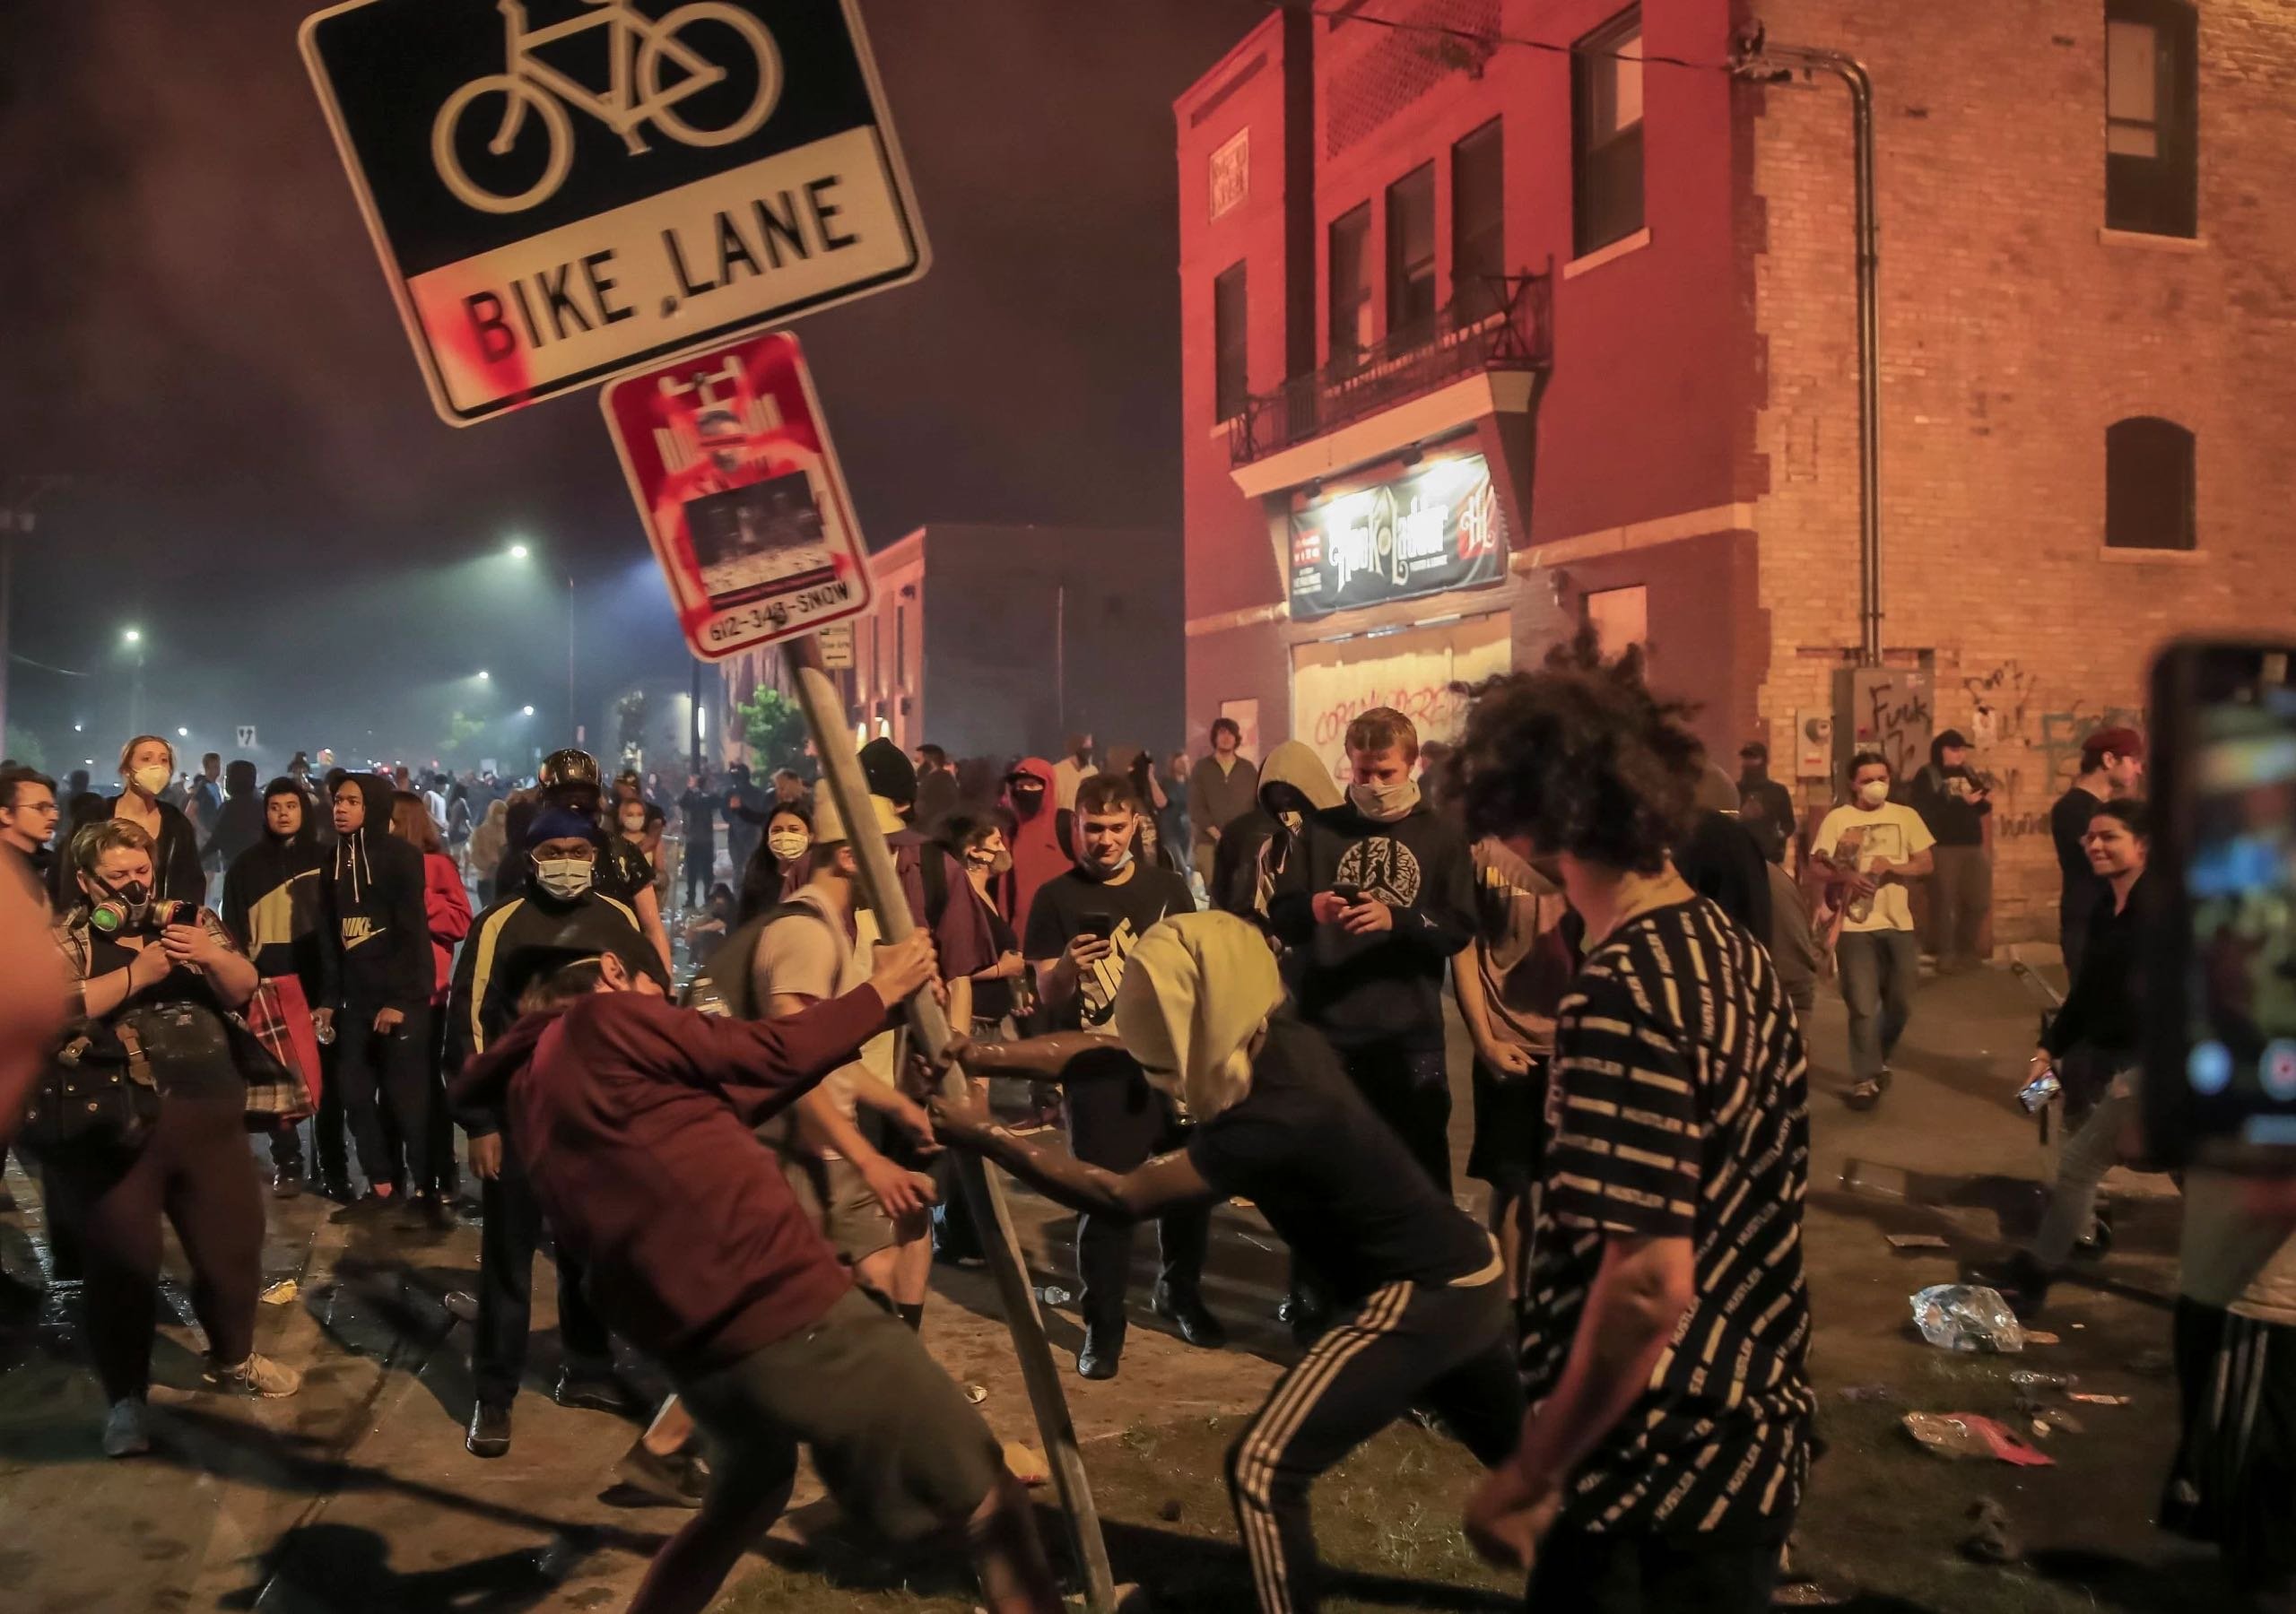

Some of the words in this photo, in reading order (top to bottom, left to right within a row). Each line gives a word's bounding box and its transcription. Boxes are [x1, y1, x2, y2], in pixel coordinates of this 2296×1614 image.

[462, 248, 633, 364] BIKE
[661, 175, 861, 299] LANE
[343, 916, 372, 937] NIKE
[1724, 1266, 1765, 1315] HUSTLER
[1726, 1443, 1762, 1497] HUSTLER
[1653, 1471, 1699, 1522] HUSTLER
